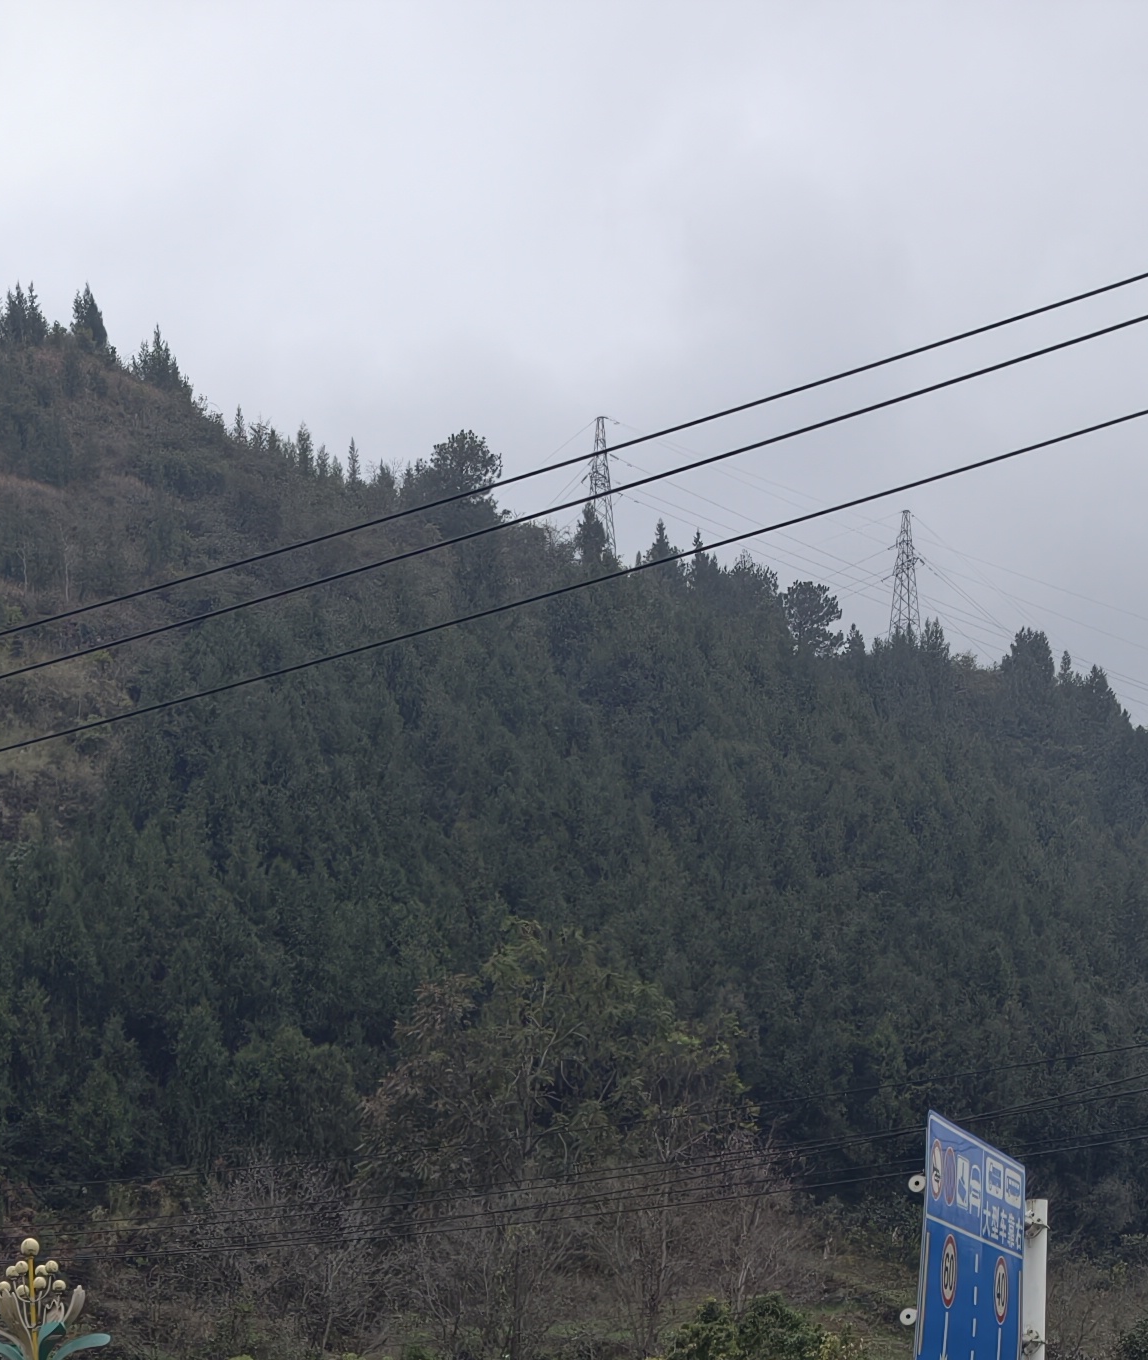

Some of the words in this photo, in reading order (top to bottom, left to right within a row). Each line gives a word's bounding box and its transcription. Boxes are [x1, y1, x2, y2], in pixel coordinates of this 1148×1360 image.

[982, 1200, 1023, 1250] 大型车靠右
[943, 1252, 954, 1291] 60
[996, 1272, 1005, 1307] 40
